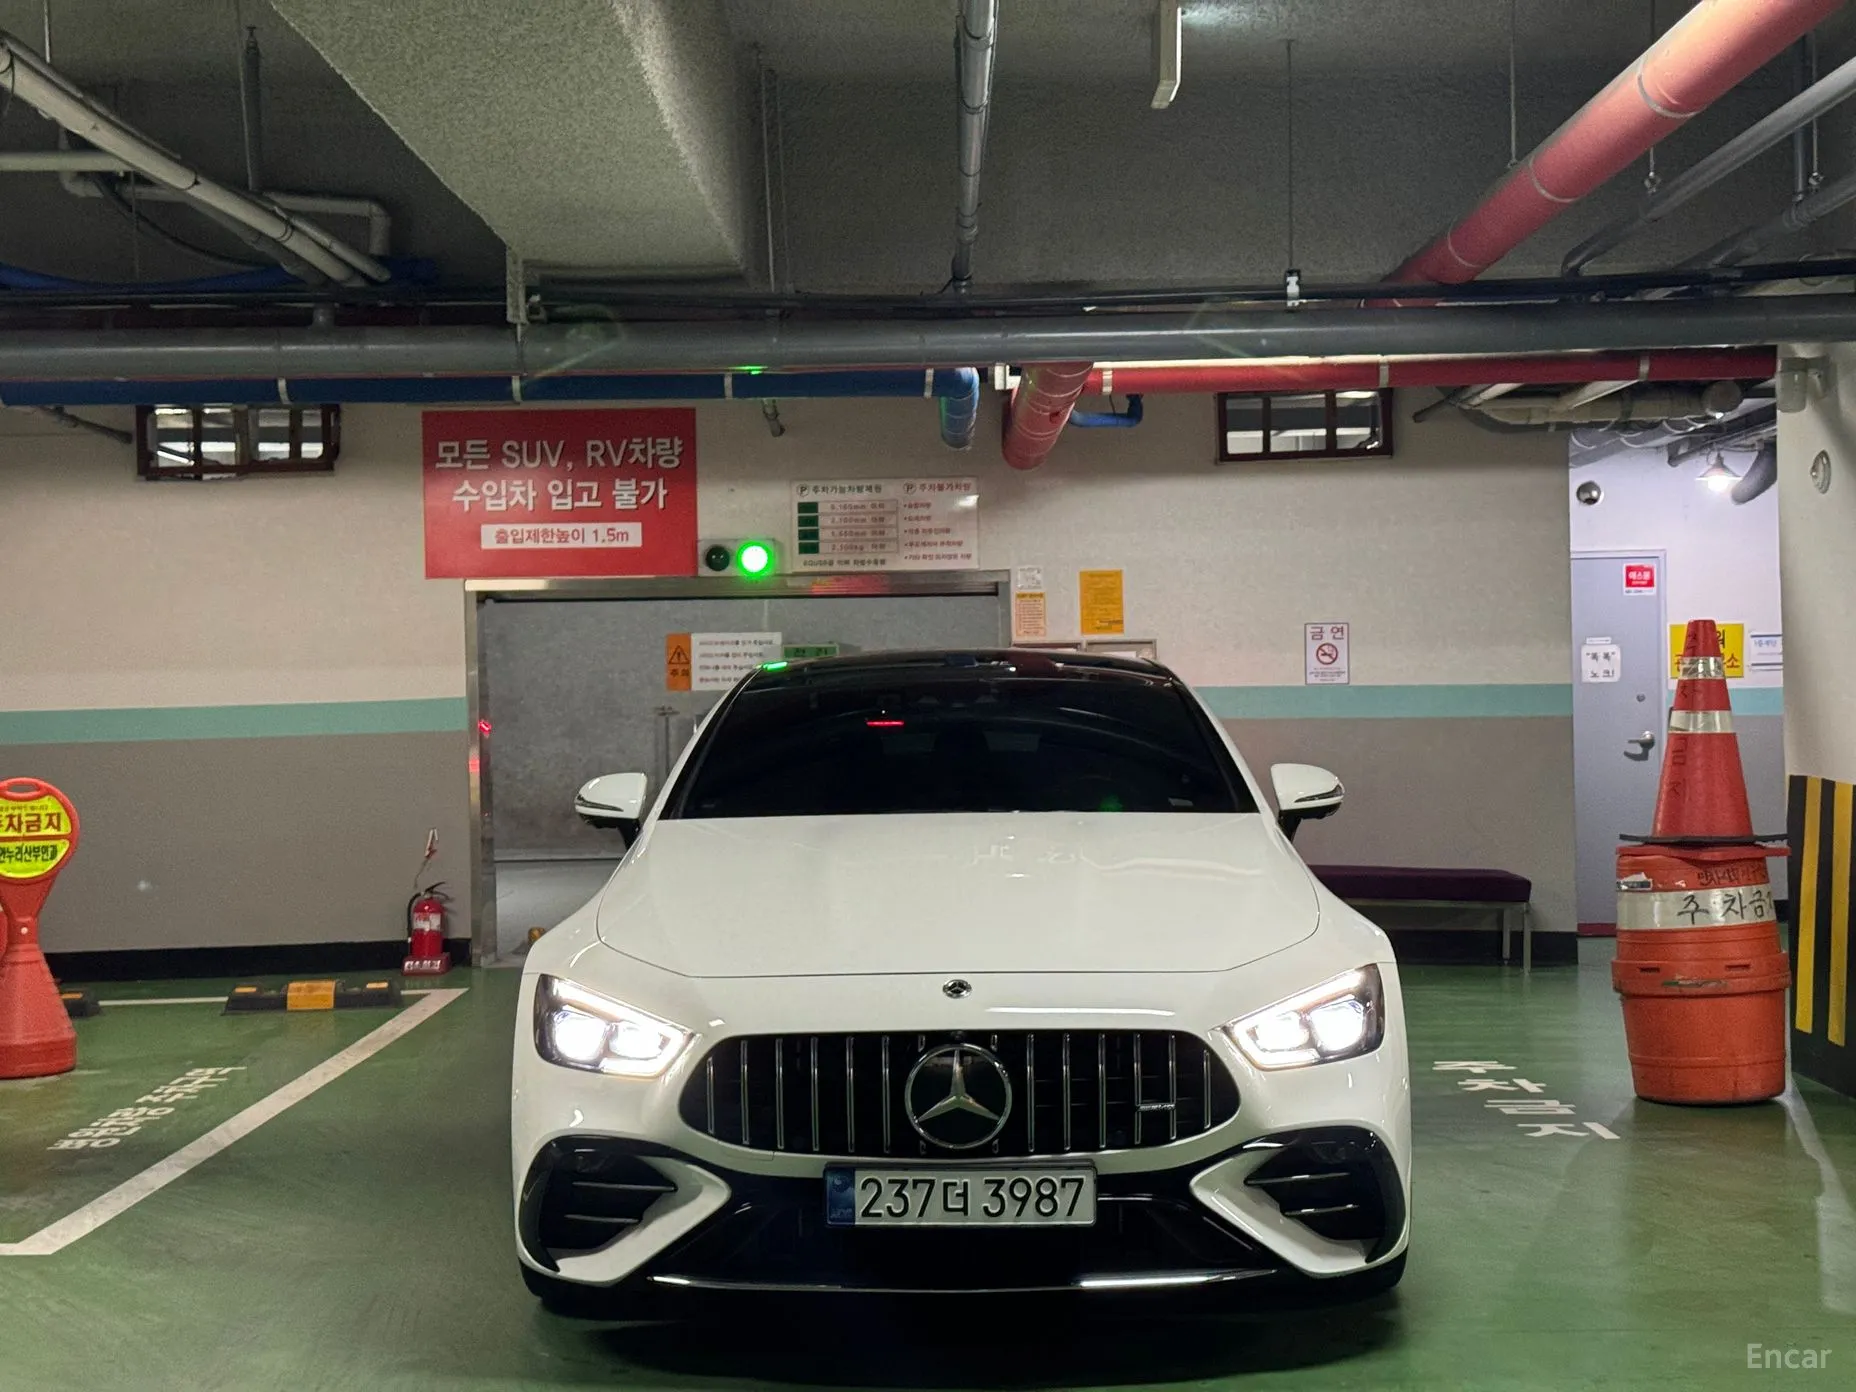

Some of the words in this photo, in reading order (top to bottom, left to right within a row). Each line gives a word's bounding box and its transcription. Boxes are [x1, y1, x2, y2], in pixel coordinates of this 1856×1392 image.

[435, 439, 490, 470] 모든
[502, 440, 574, 471] SUV,
[586, 436, 683, 469] RV차량
[452, 479, 537, 511] 수입차
[547, 478, 602, 511] 입고
[611, 477, 668, 509] 불가
[495, 527, 585, 545] 출입제한높이
[592, 526, 629, 542] 1.5m
[861, 1177, 969, 1218] 237더
[982, 1177, 1085, 1218] 3987
